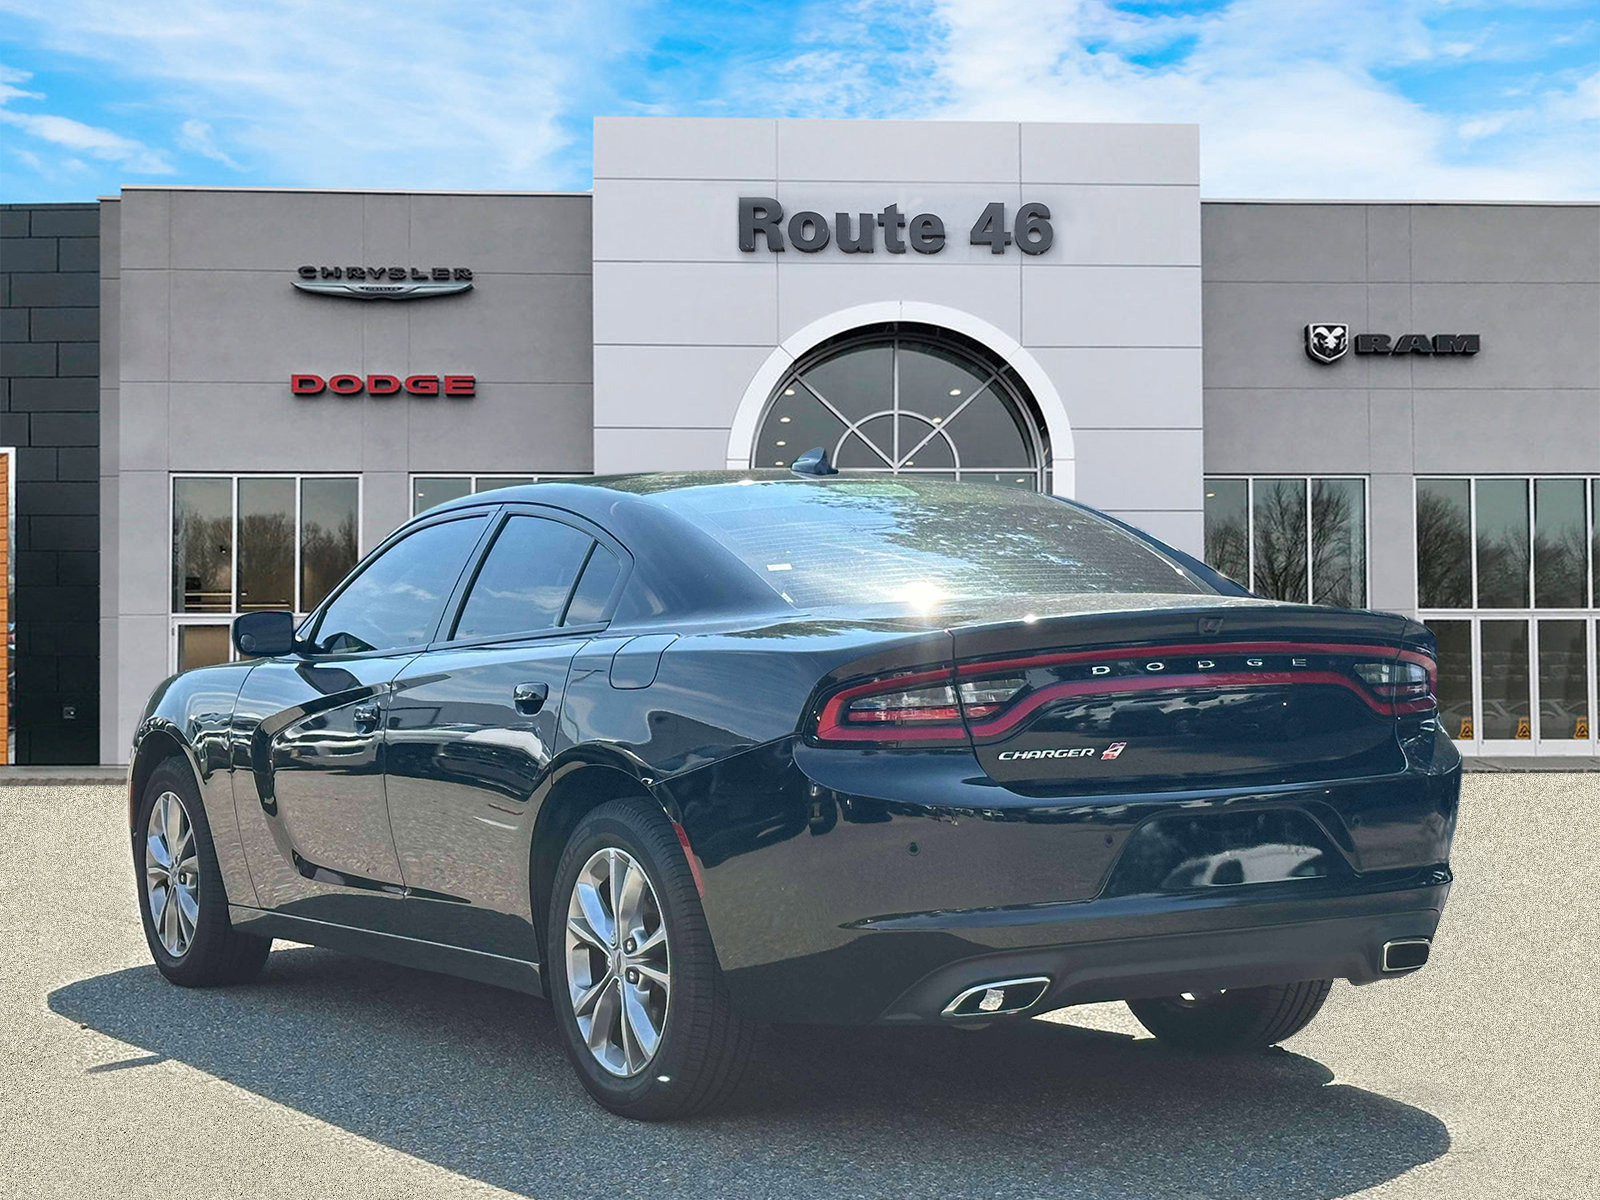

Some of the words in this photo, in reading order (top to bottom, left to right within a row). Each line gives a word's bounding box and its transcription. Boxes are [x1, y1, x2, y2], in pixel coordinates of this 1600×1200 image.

[738, 197, 946, 255] Route
[969, 202, 1054, 256] 46
[298, 265, 474, 280] CHRYSLER
[1354, 333, 1481, 357] RAM
[291, 374, 476, 397] DODGE
[1091, 657, 1308, 676] DODGE
[998, 747, 1096, 761] CHARGER
